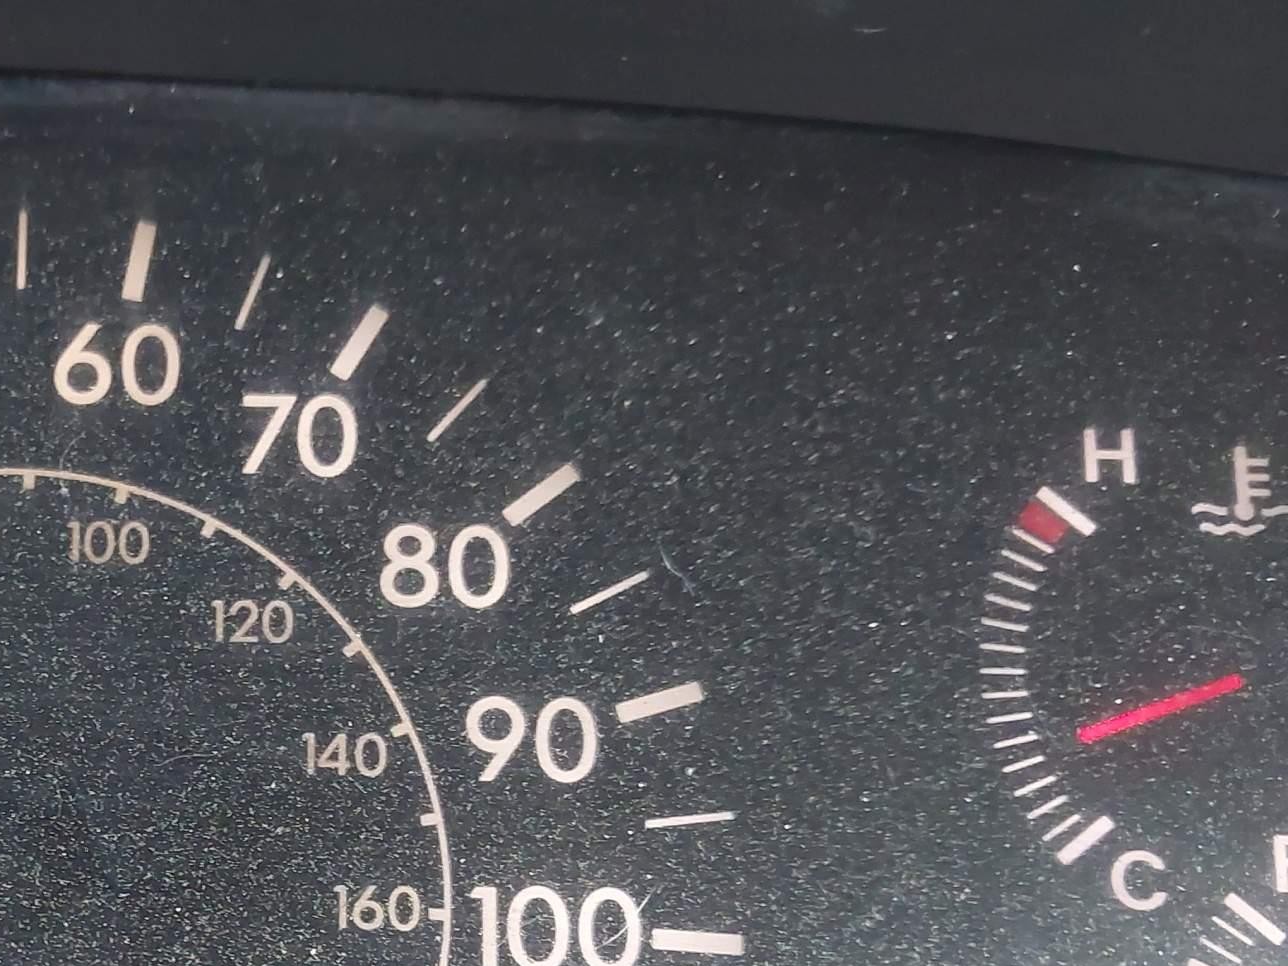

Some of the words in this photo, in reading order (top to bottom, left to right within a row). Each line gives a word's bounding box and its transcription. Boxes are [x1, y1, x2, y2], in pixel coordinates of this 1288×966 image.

[52, 322, 181, 405] 60
[241, 393, 359, 478] 70
[1083, 427, 1137, 484] H
[67, 520, 150, 565] 100
[379, 522, 511, 610] 80
[212, 600, 295, 644] 120
[302, 731, 388, 778] 140
[465, 695, 598, 784] 90
[334, 884, 421, 932] 160
[1110, 848, 1167, 912] C
